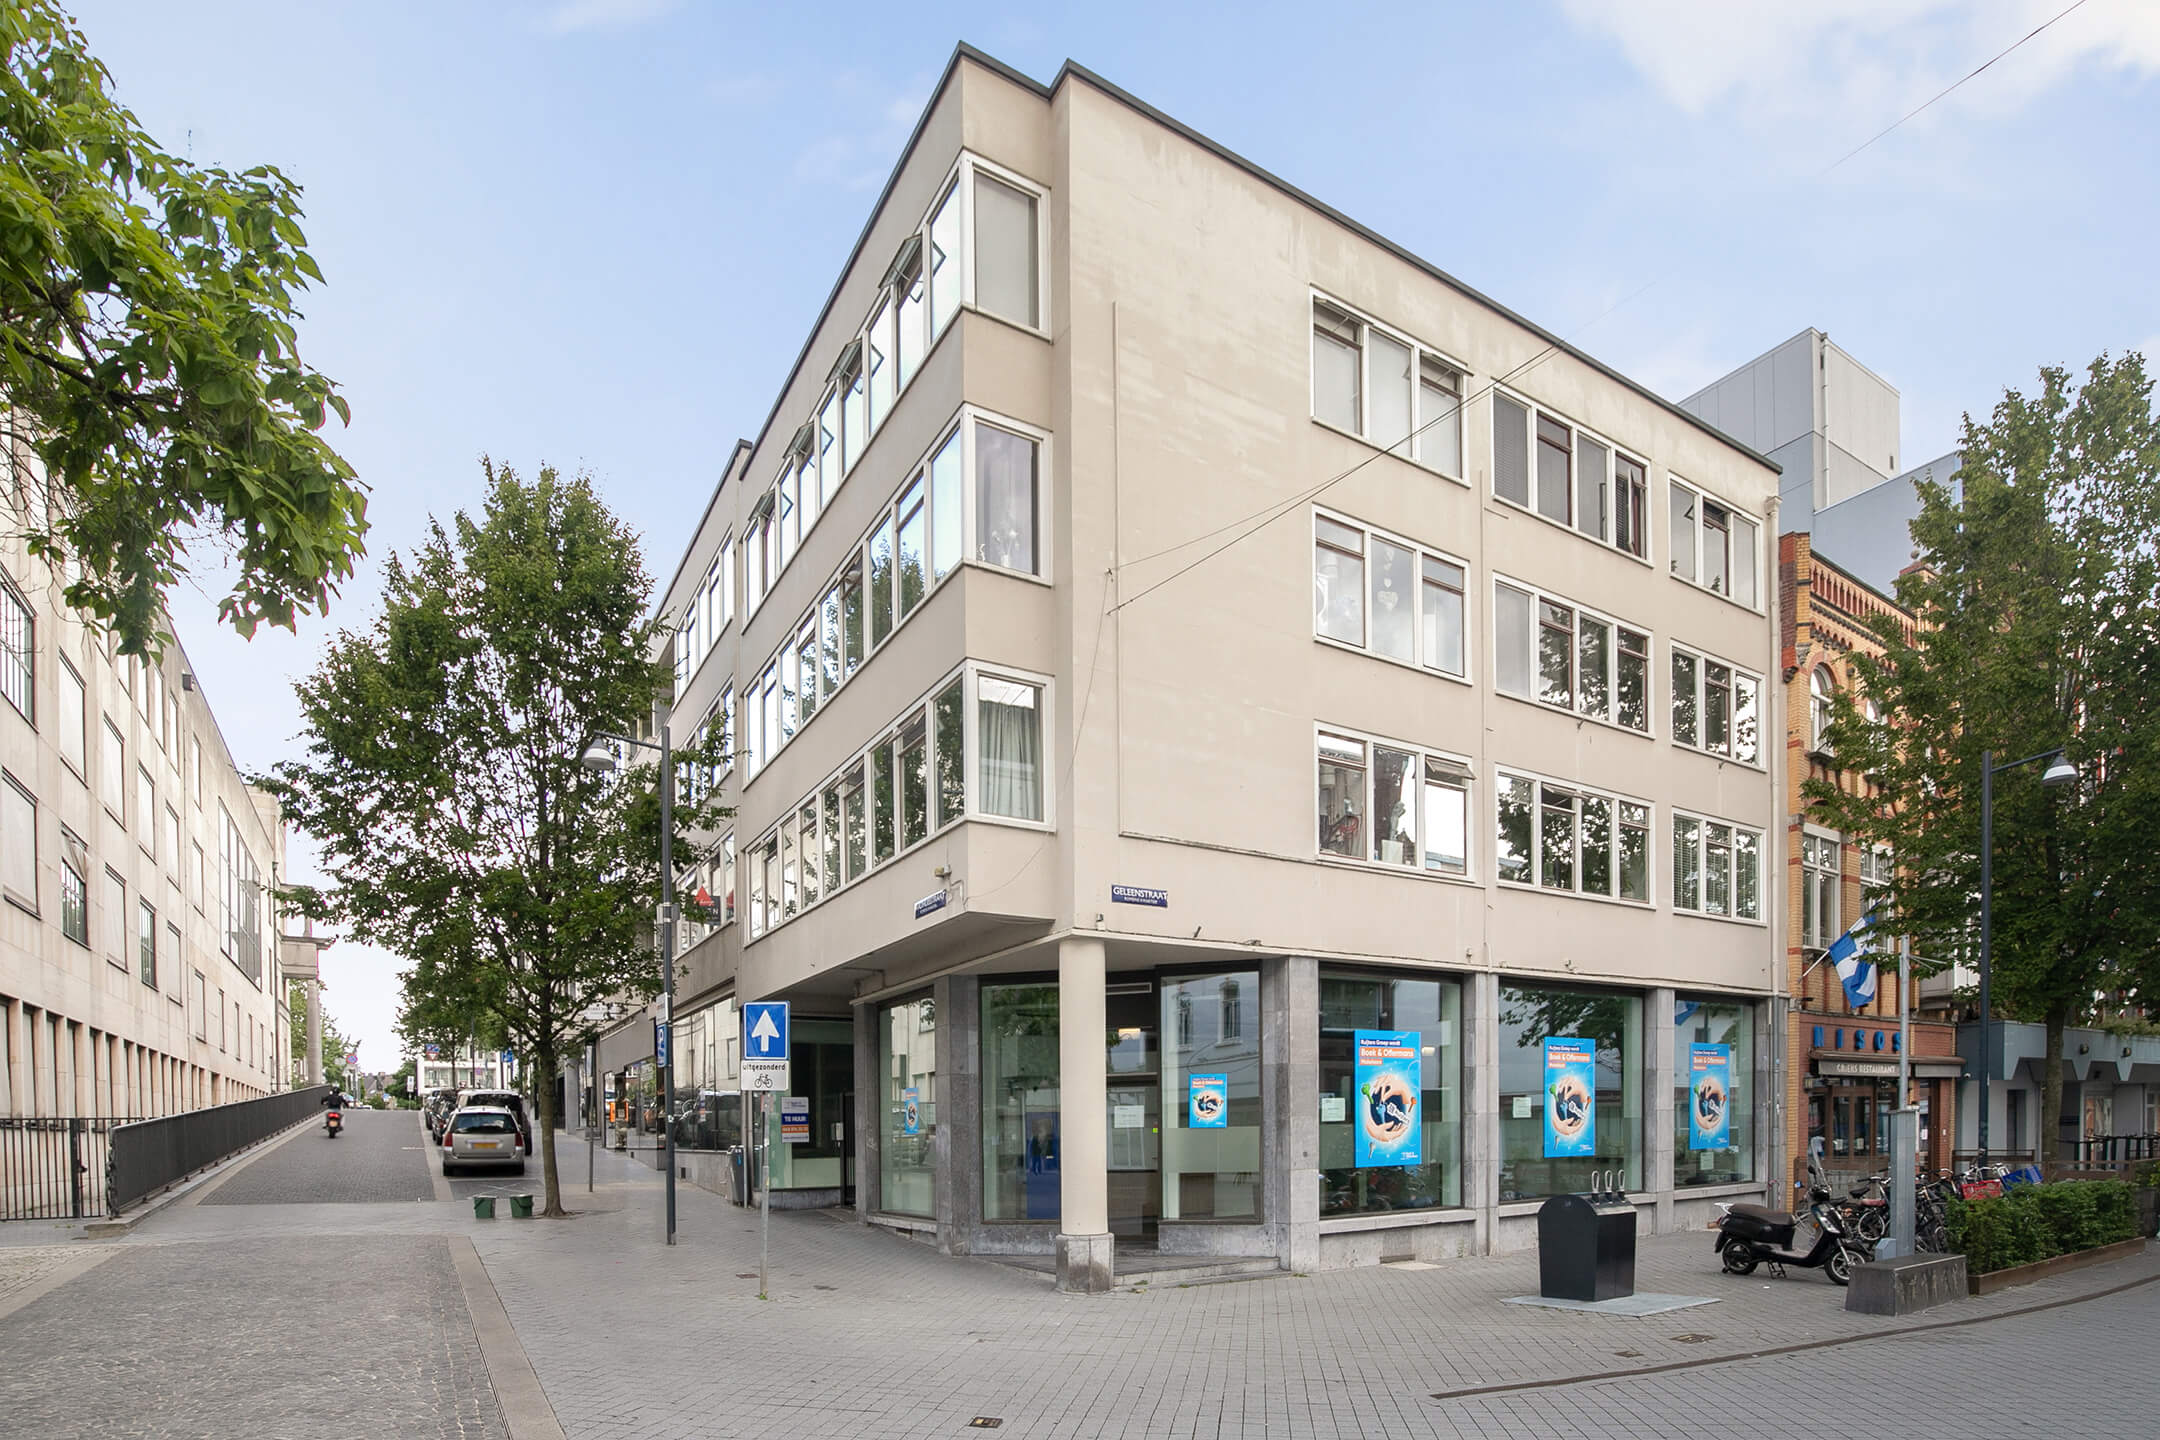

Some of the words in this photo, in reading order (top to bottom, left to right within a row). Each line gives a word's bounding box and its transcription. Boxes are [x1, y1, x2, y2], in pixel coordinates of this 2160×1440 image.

[1113, 886, 1168, 901] GELEENSTRAAT
[1361, 1048, 1376, 1057] Boek
[742, 1062, 786, 1073] uitgezonderd
[1859, 1063, 1896, 1074] RESTAURANT
[784, 1115, 792, 1123] TE
